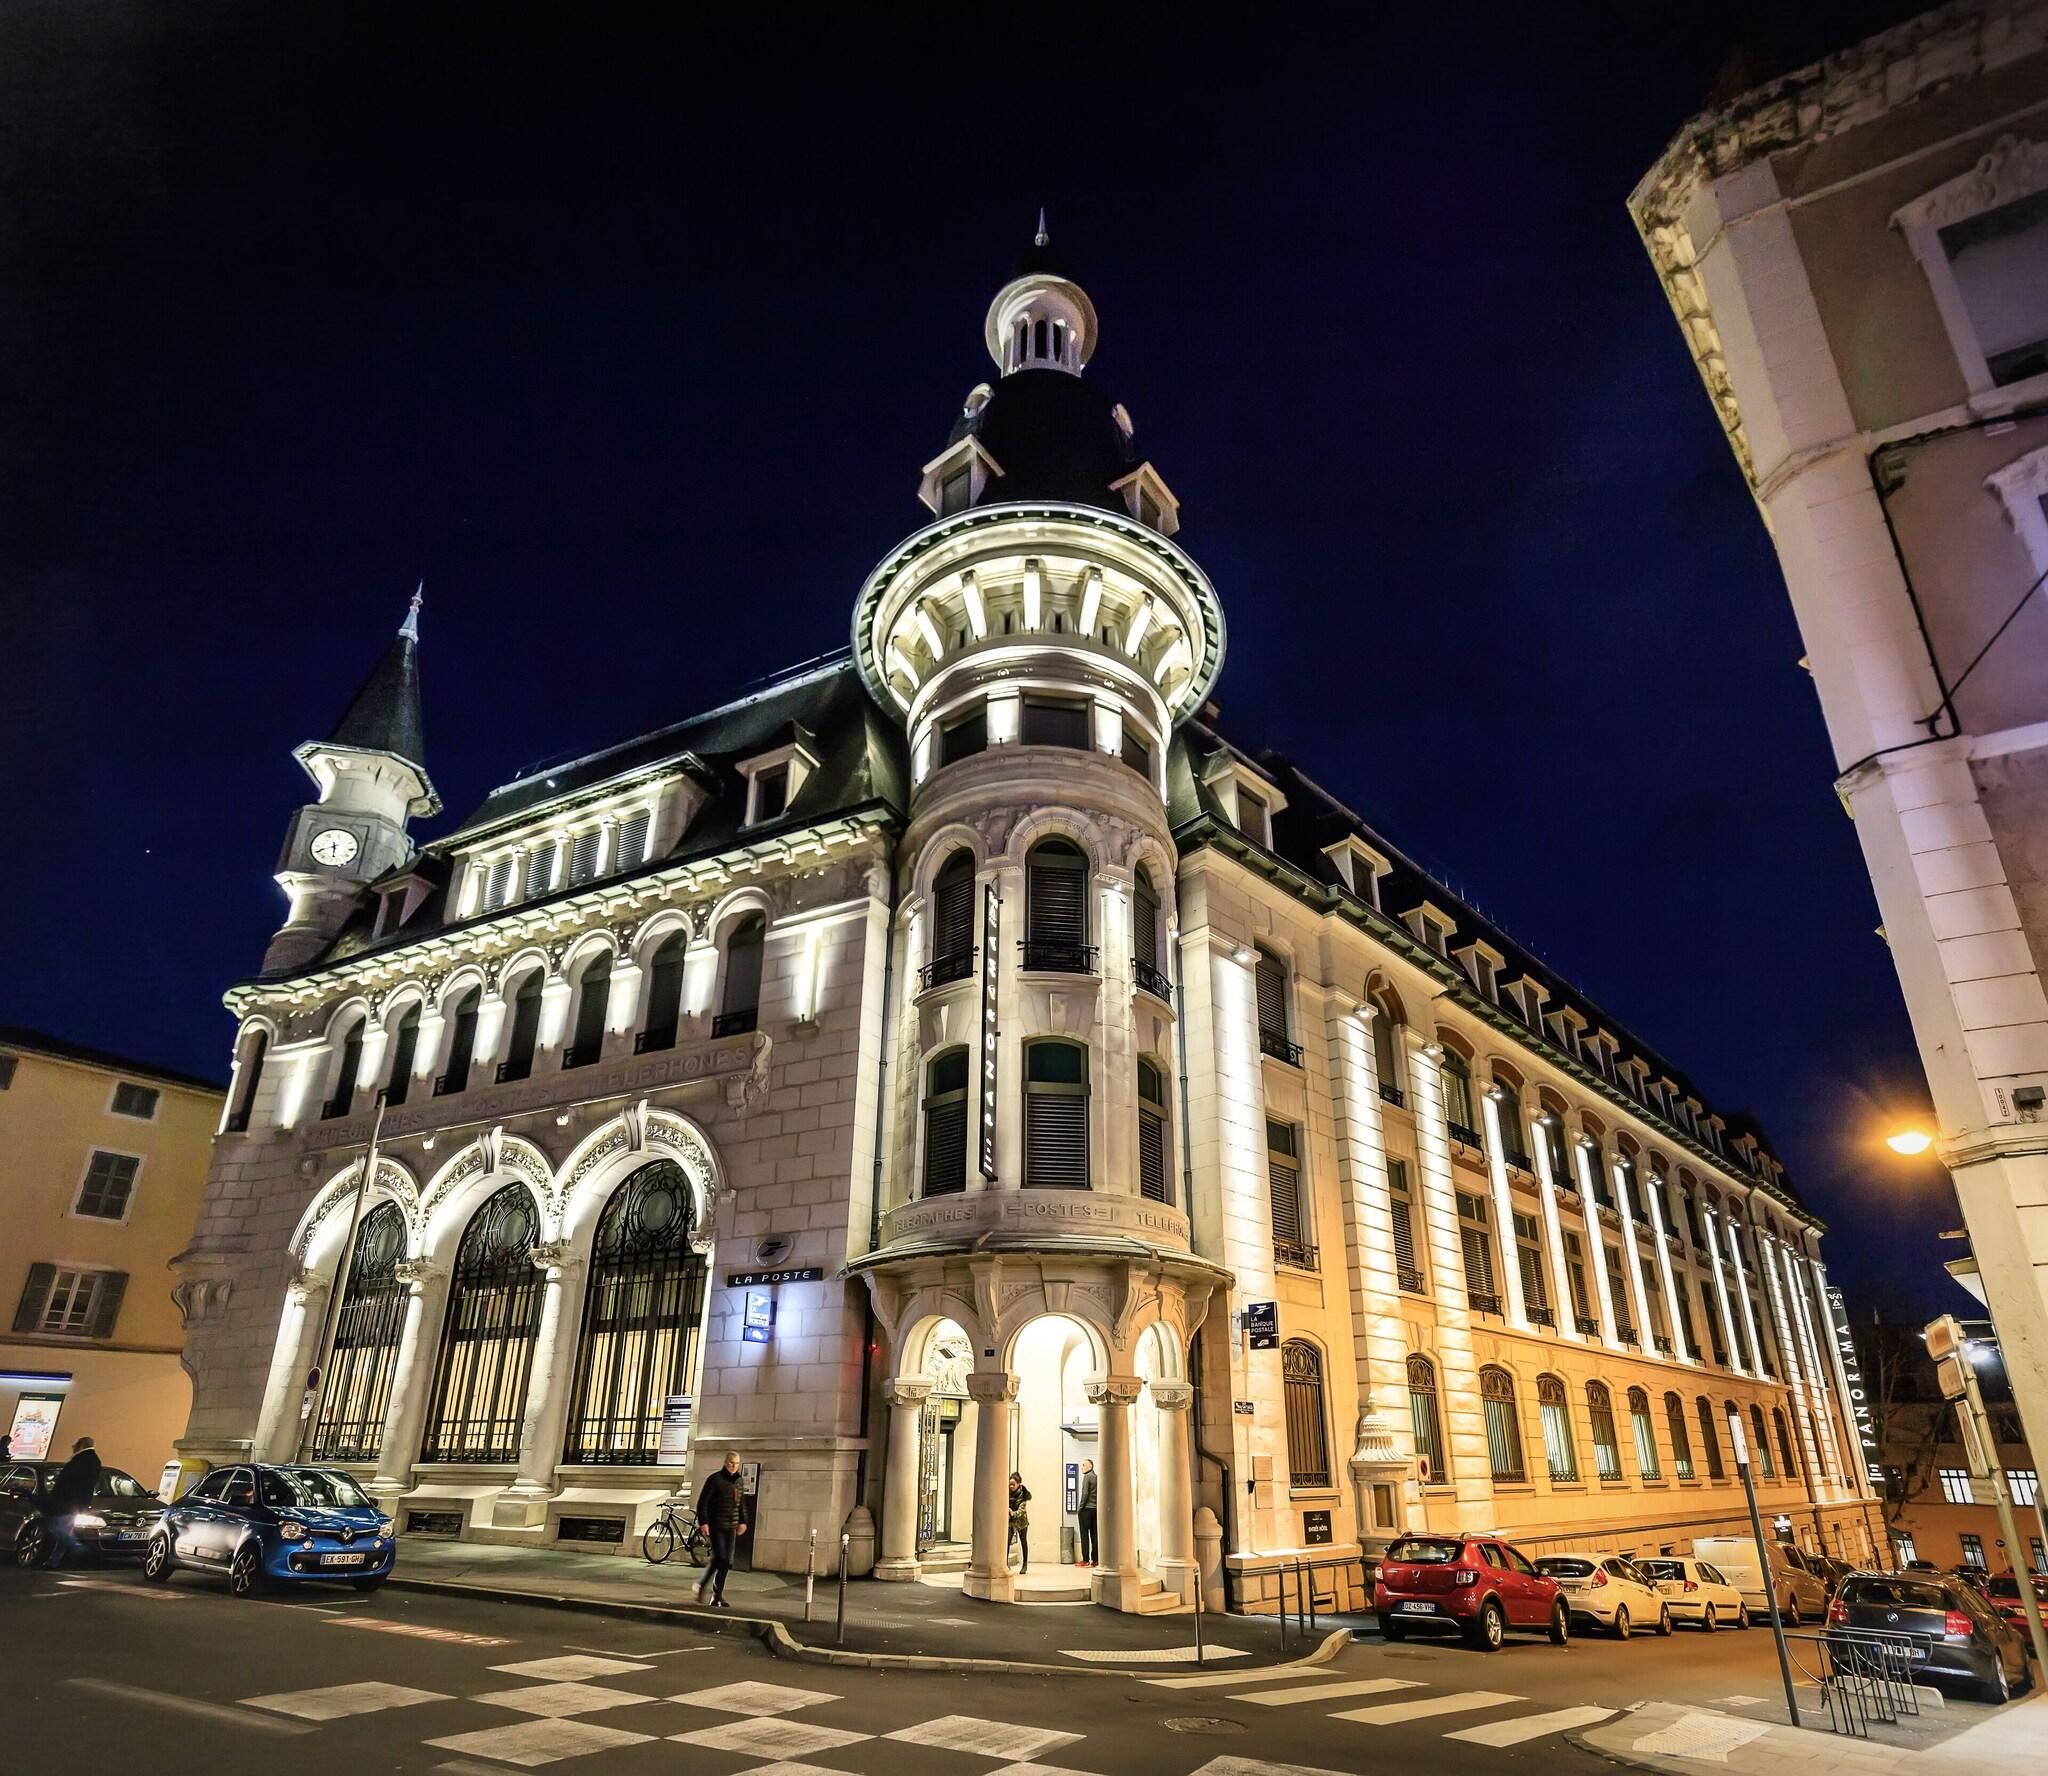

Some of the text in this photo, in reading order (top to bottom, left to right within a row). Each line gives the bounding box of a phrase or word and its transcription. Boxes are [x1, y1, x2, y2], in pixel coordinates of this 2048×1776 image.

[1024, 1202, 1091, 1218] POSTES
[735, 1270, 811, 1285] LA POSTE
[1836, 1324, 1876, 1447] PANORAMA
